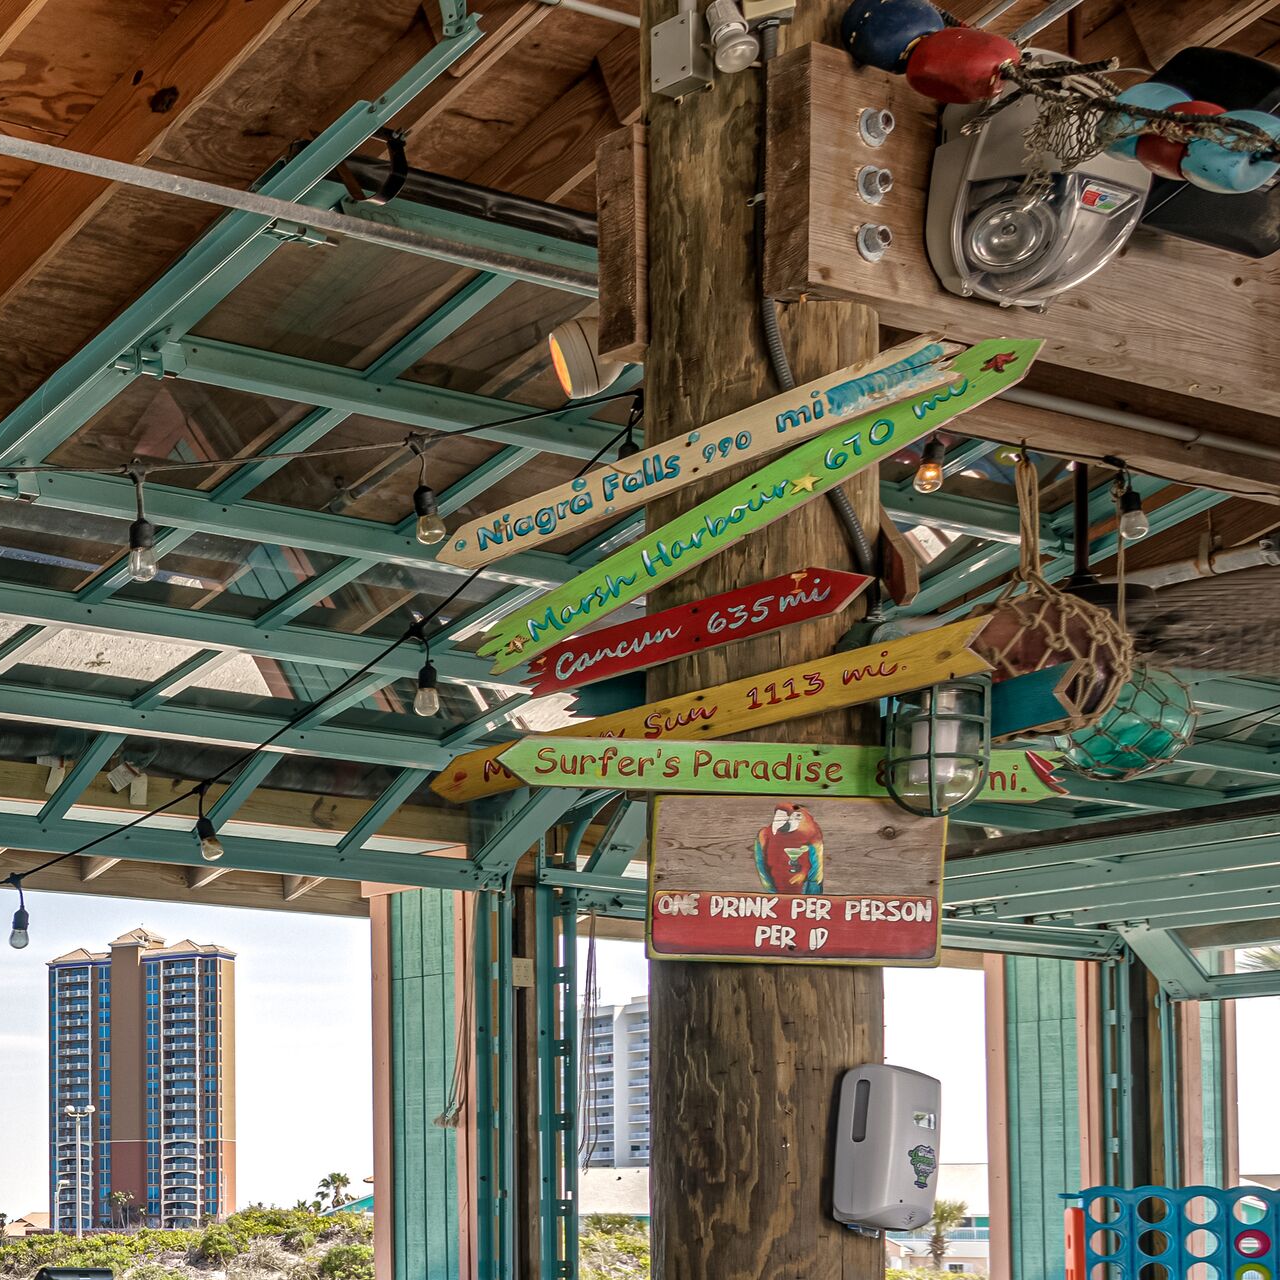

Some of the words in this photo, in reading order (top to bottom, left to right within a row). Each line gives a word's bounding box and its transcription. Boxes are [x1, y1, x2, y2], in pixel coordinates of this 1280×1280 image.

[476, 490, 594, 551] Niagra
[602, 453, 681, 502] Falls
[702, 430, 753, 464] 990
[775, 389, 825, 433] mi
[527, 571, 638, 642] Marsh
[641, 478, 790, 577] Harbour
[824, 418, 895, 470] 670
[554, 625, 683, 682] Cancun
[706, 595, 775, 635] 635
[779, 577, 832, 613] mi
[643, 704, 718, 740] Sun
[746, 672, 826, 711] 1113
[842, 650, 908, 686] mi.
[534, 747, 682, 778] Surfer's
[692, 750, 844, 783] Paradise
[656, 893, 701, 917] ONE
[709, 896, 780, 920] DRINK
[791, 898, 833, 920] PER
[844, 899, 933, 923] PERSON
[755, 925, 797, 949] PER
[808, 926, 830, 951] ID
